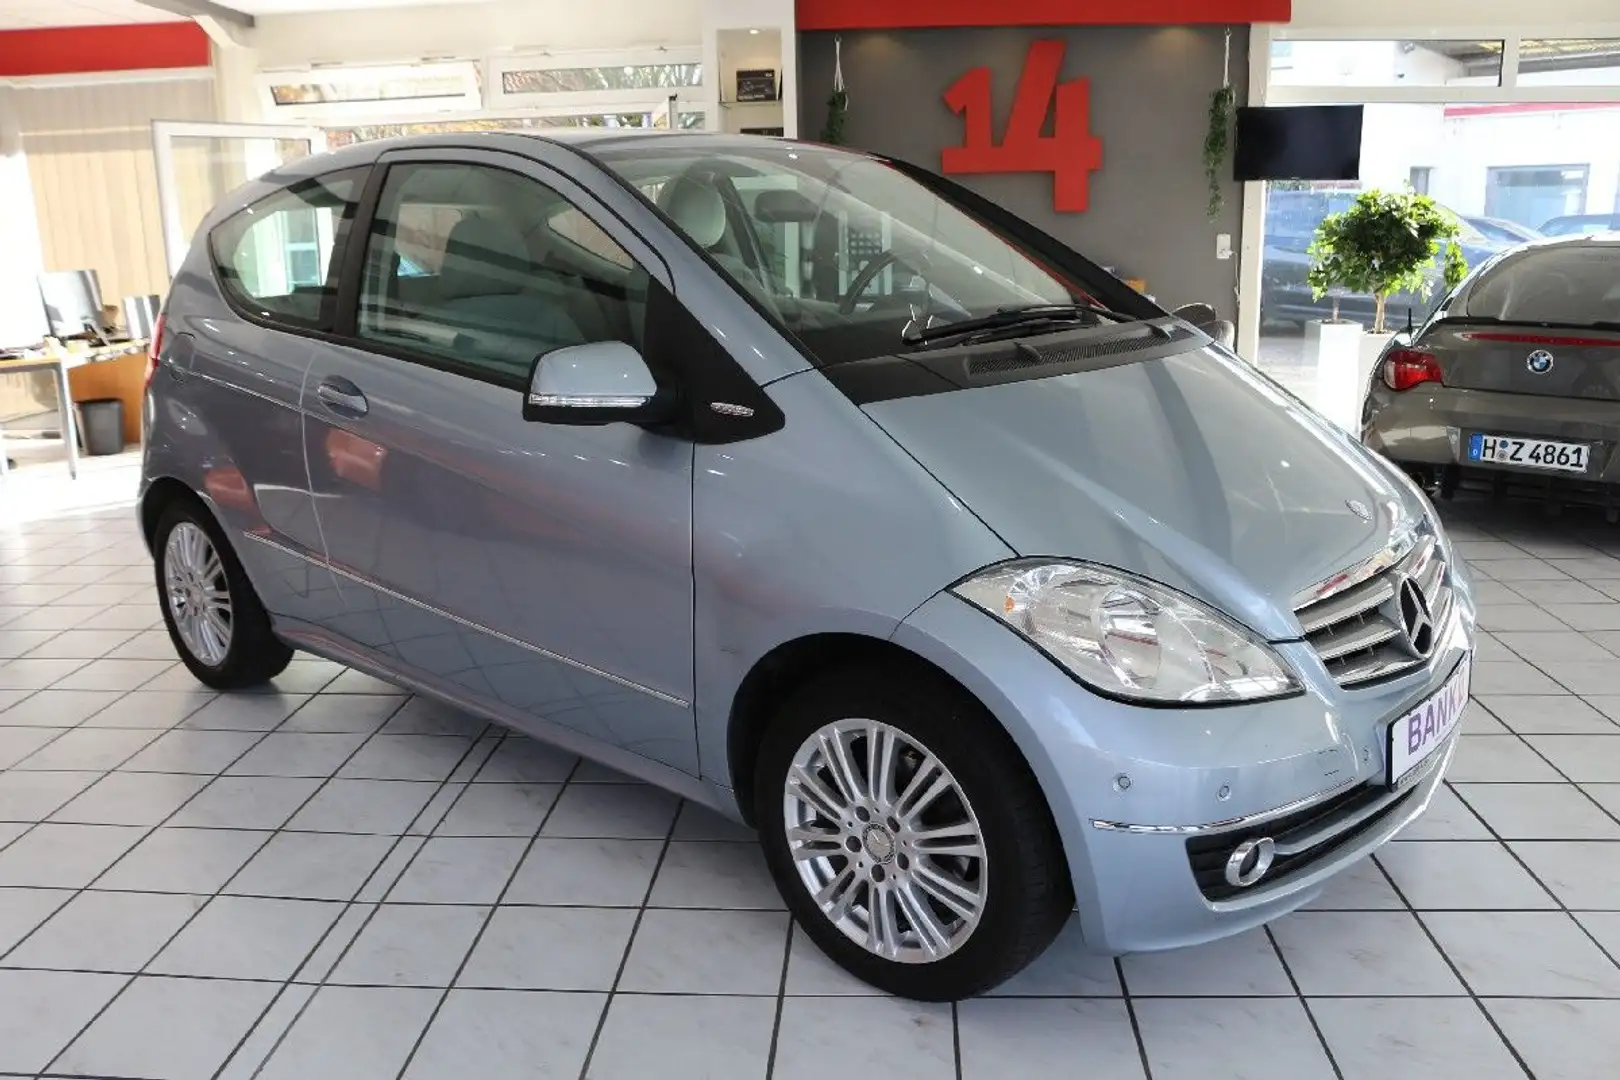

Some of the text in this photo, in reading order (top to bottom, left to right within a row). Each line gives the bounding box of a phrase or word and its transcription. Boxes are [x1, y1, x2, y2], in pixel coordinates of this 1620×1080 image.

[942, 41, 1102, 211] 14
[1483, 439, 1583, 468] H Z 4861
